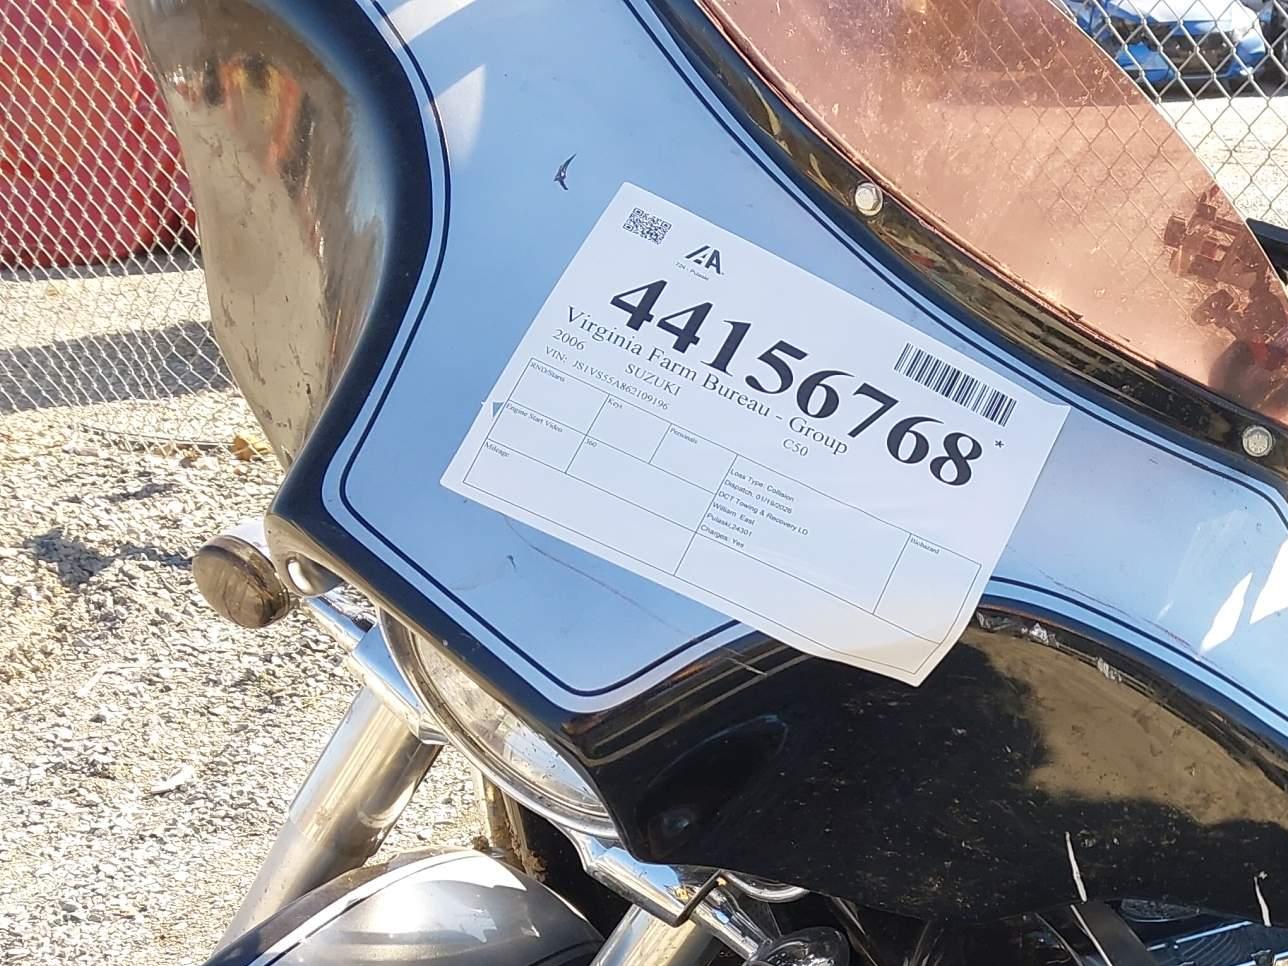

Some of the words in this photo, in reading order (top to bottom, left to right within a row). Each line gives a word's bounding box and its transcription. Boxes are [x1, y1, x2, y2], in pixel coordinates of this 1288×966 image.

[546, 345, 568, 363] VIN:
[552, 329, 585, 350] 2006
[625, 363, 681, 396] SUZUKI
[783, 438, 809, 457] C50
[568, 306, 643, 356] Virginia
[647, 347, 697, 382] Farm
[702, 372, 770, 417] Bureau
[789, 416, 848, 455] Group
[610, 279, 983, 486] 44156768
[505, 400, 529, 417] Engine
[529, 413, 544, 424] Start
[545, 416, 566, 433] Video
[730, 468, 746, 480] Loss
[732, 537, 745, 548] Yes
